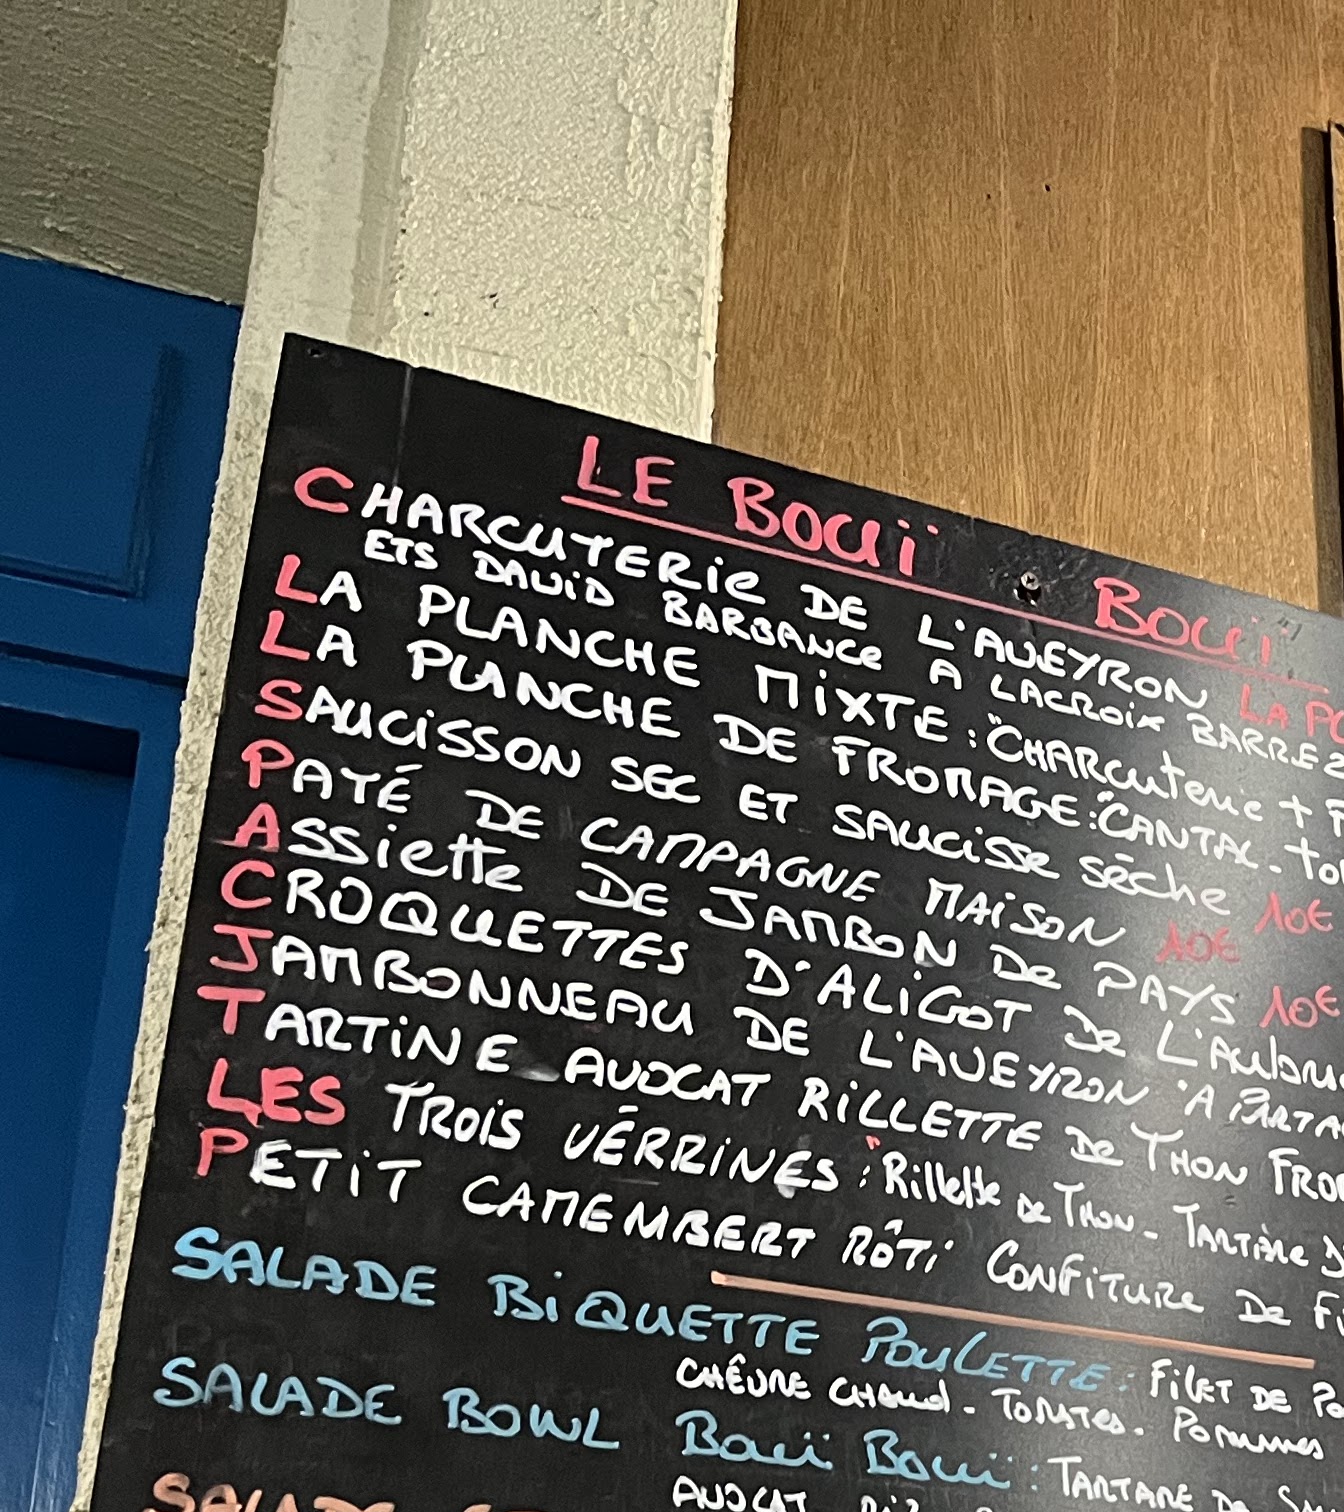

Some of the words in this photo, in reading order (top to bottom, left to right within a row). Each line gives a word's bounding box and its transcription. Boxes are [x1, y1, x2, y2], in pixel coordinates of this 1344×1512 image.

[578, 436, 676, 507] LE
[275, 555, 361, 611] LA
[419, 583, 700, 688] PLANCHE
[801, 583, 868, 630] DE
[1240, 684, 1288, 730] LA
[260, 611, 357, 667] LA
[406, 640, 681, 740] PLANCHE
[713, 714, 799, 763] DE
[465, 790, 544, 839] DE
[580, 816, 881, 902] CAMPAGNE
[611, 757, 700, 803] SEC
[739, 786, 798, 823] ET
[1254, 892, 1333, 934] 10€
[220, 859, 688, 975] CROQUETTES
[577, 861, 669, 917] DE
[701, 886, 957, 968] JAMBON
[1093, 962, 1235, 1024] PAYS
[1259, 984, 1340, 1028] 10€
[210, 924, 694, 1035] JAMBONNEAU
[733, 1006, 810, 1056] DE
[207, 1058, 345, 1127] LES
[1131, 1122, 1248, 1186] THON
[172, 1227, 437, 1307] SALADE
[462, 1175, 816, 1259] CAMEMBERT
[153, 1356, 402, 1426] SALADE
[441, 1385, 620, 1450] BOWL
